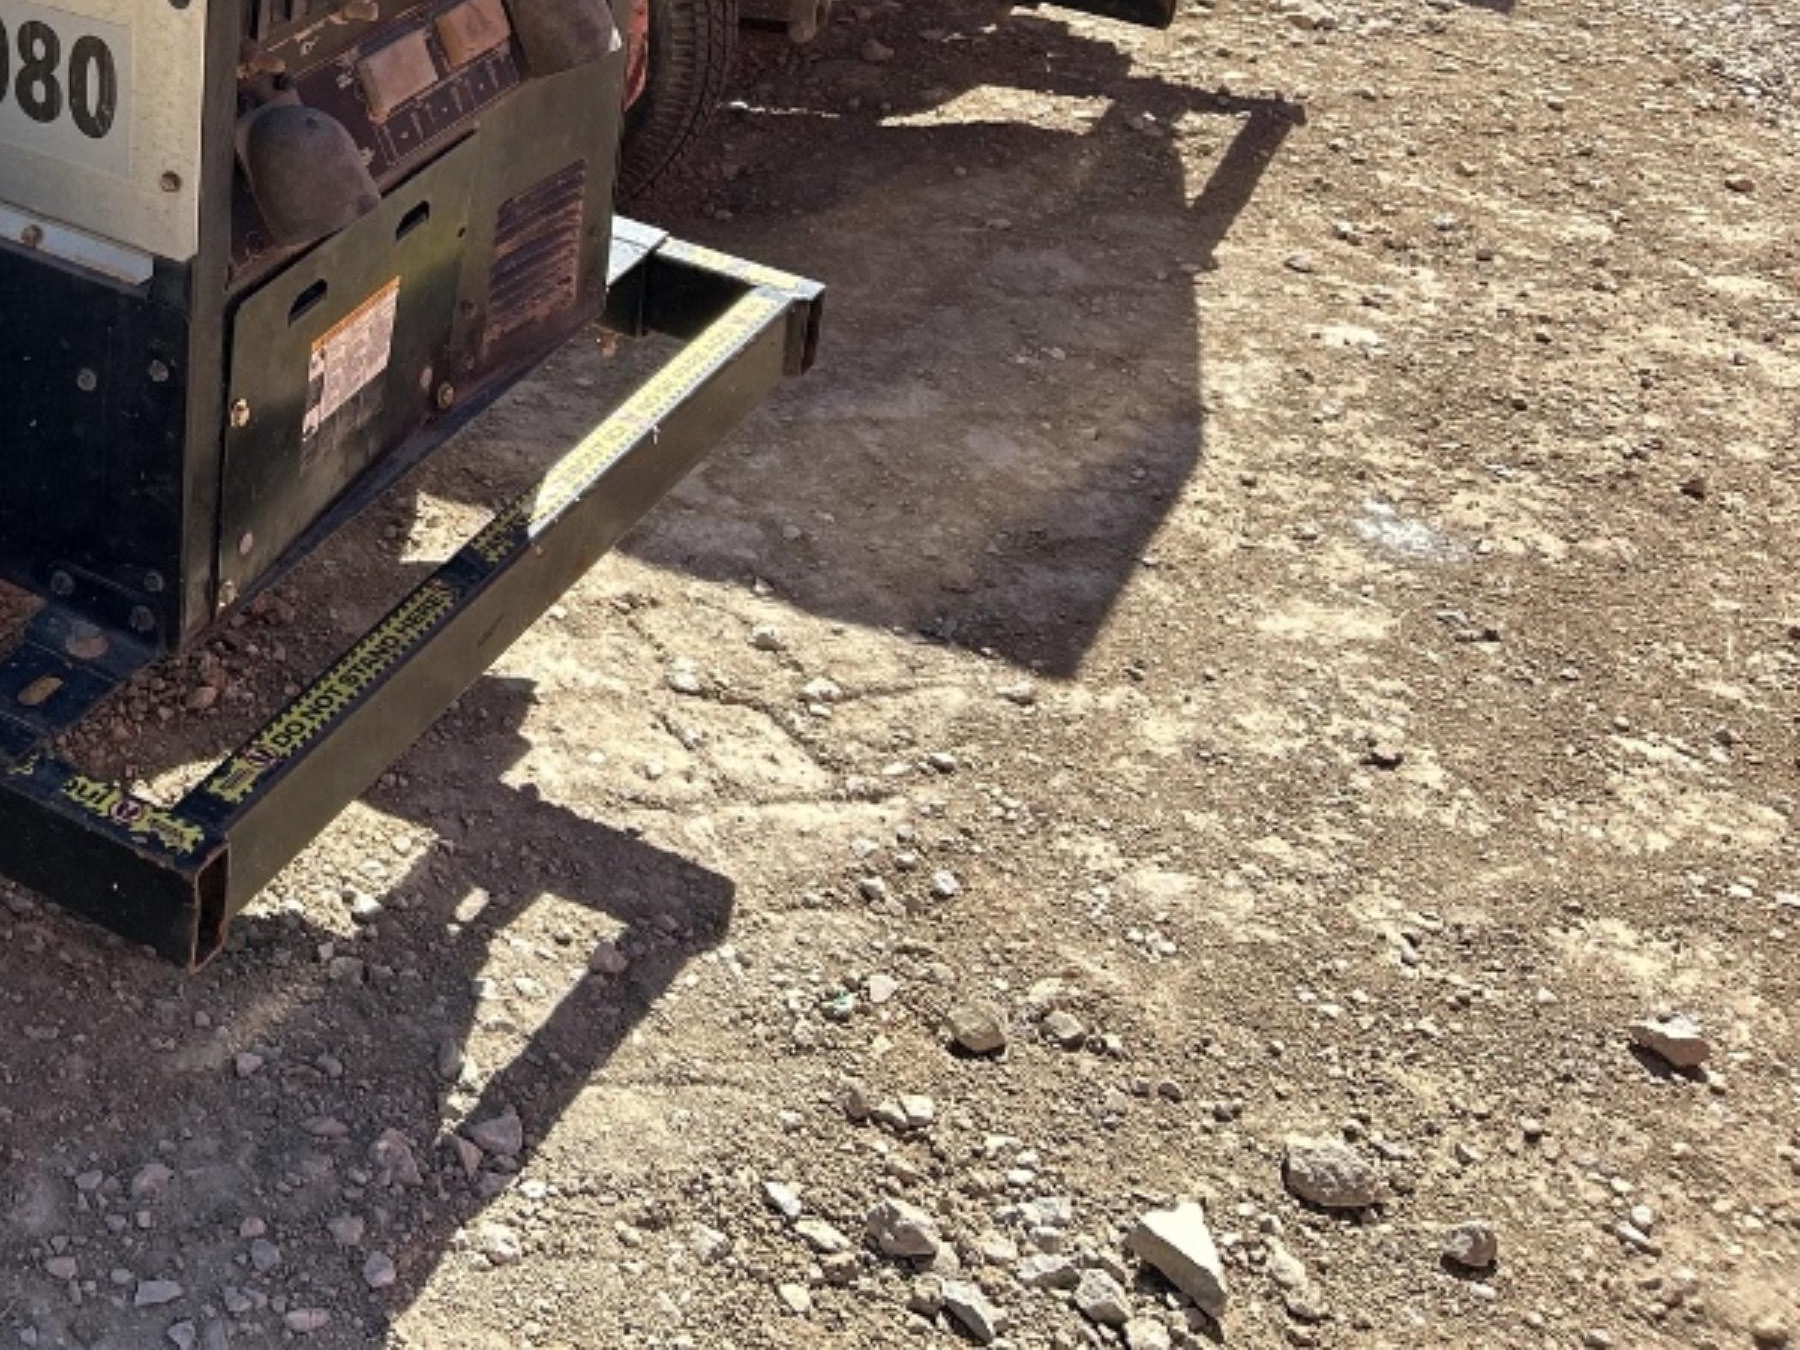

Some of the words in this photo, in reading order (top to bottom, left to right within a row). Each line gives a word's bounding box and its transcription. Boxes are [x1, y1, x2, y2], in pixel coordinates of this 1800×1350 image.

[271, 719, 307, 748] DO
[301, 685, 344, 722] NOT
[338, 634, 401, 686] STAND
